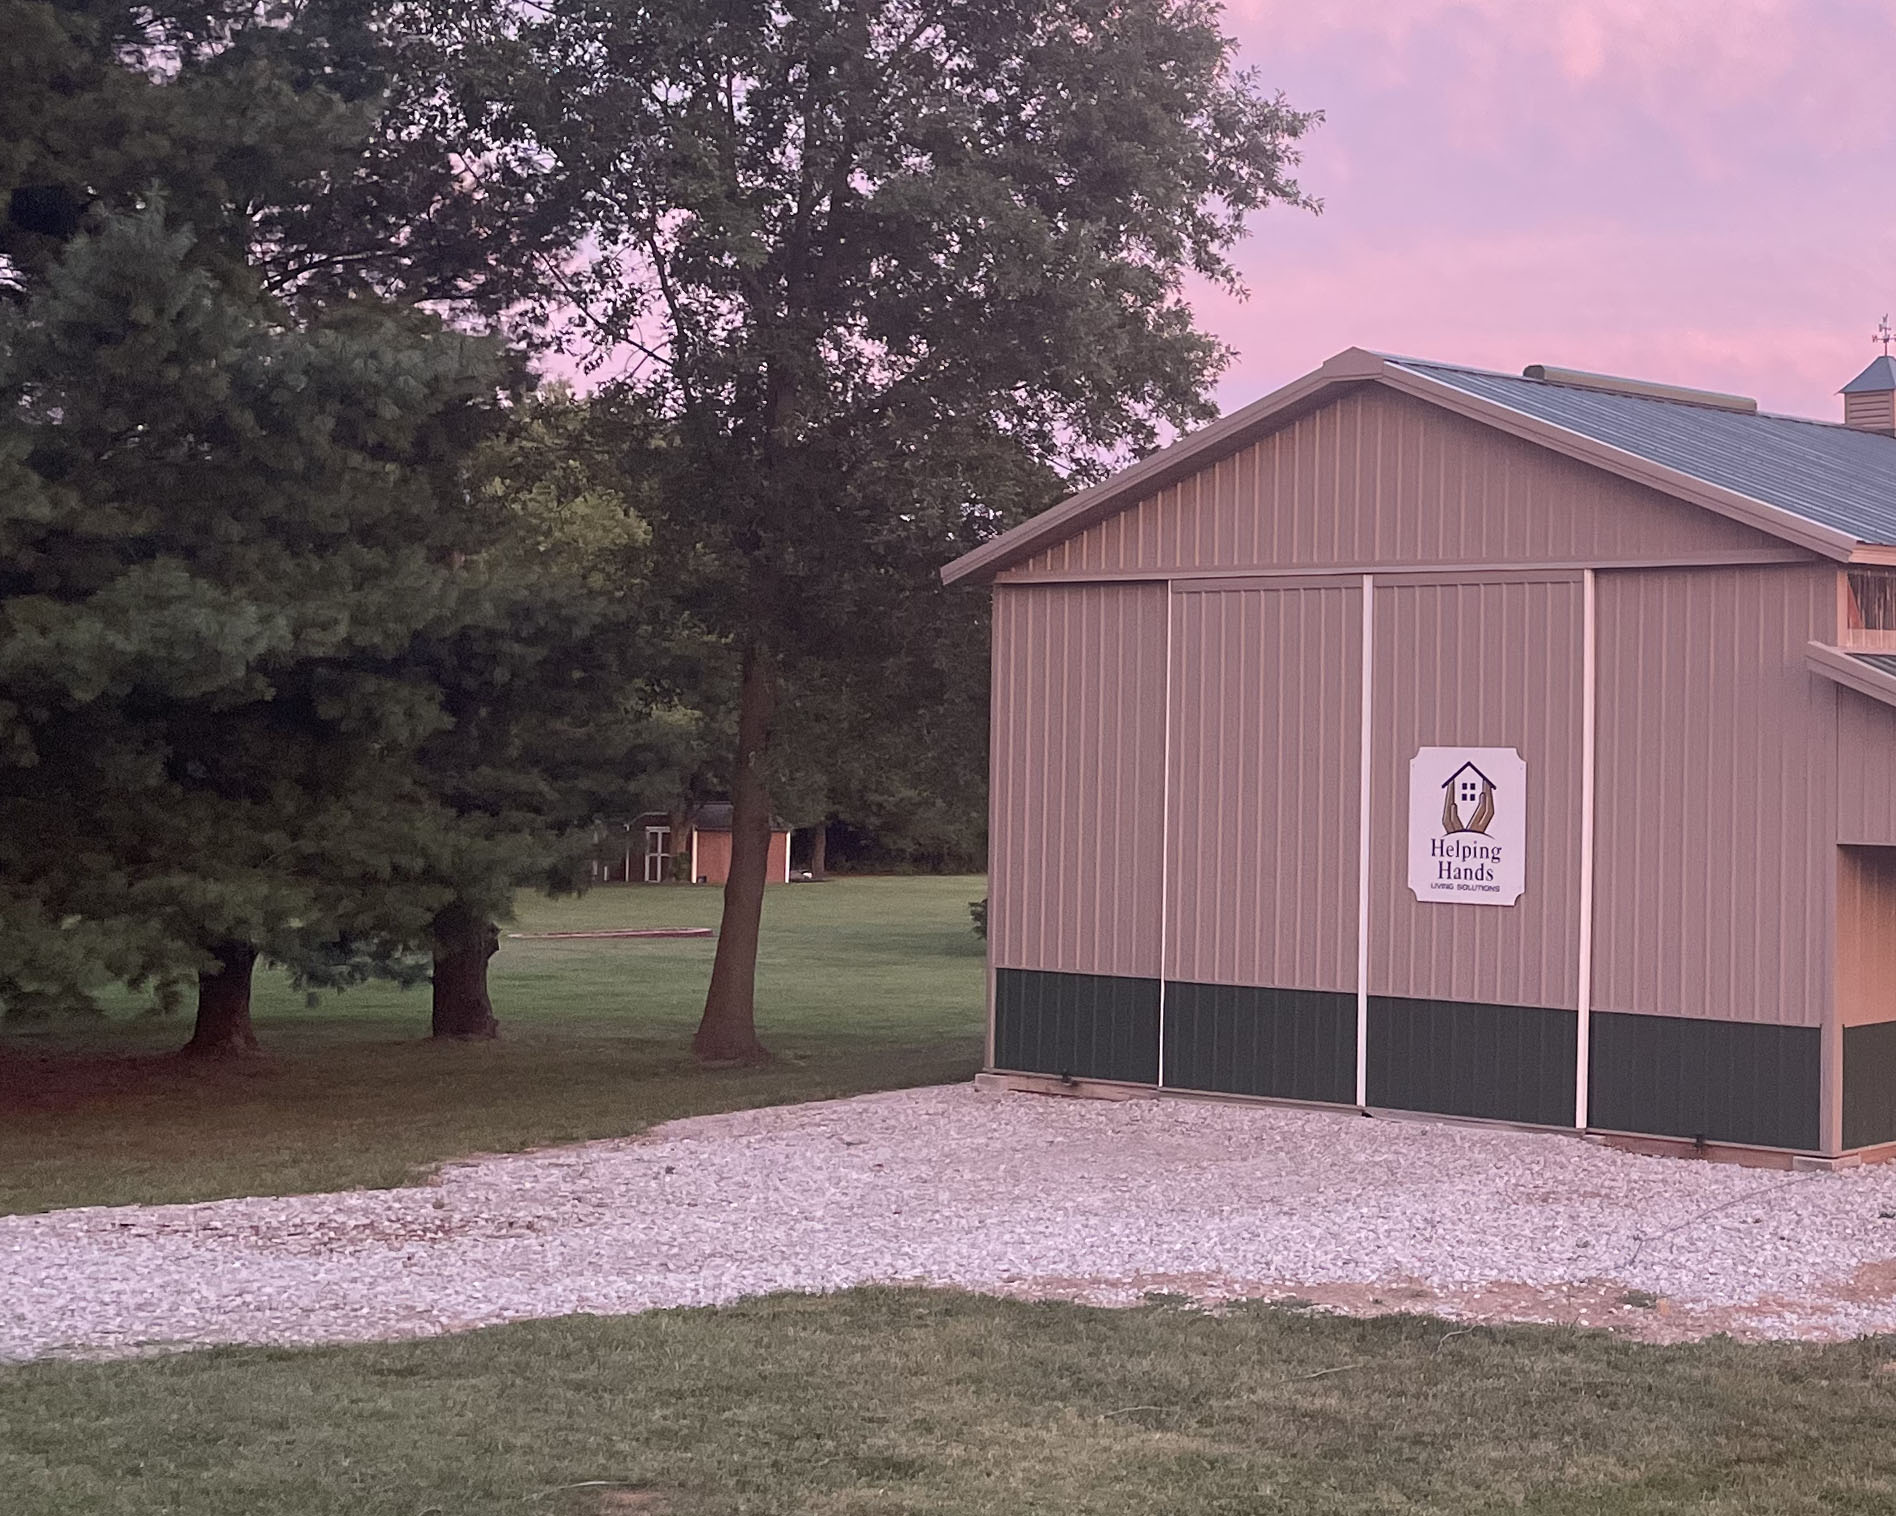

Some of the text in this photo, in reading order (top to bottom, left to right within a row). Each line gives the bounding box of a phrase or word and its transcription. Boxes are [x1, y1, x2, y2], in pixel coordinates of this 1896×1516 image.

[1431, 838, 1502, 863] Helping
[1438, 860, 1494, 882] Hands
[1457, 884, 1501, 892] SOLUTIONS
